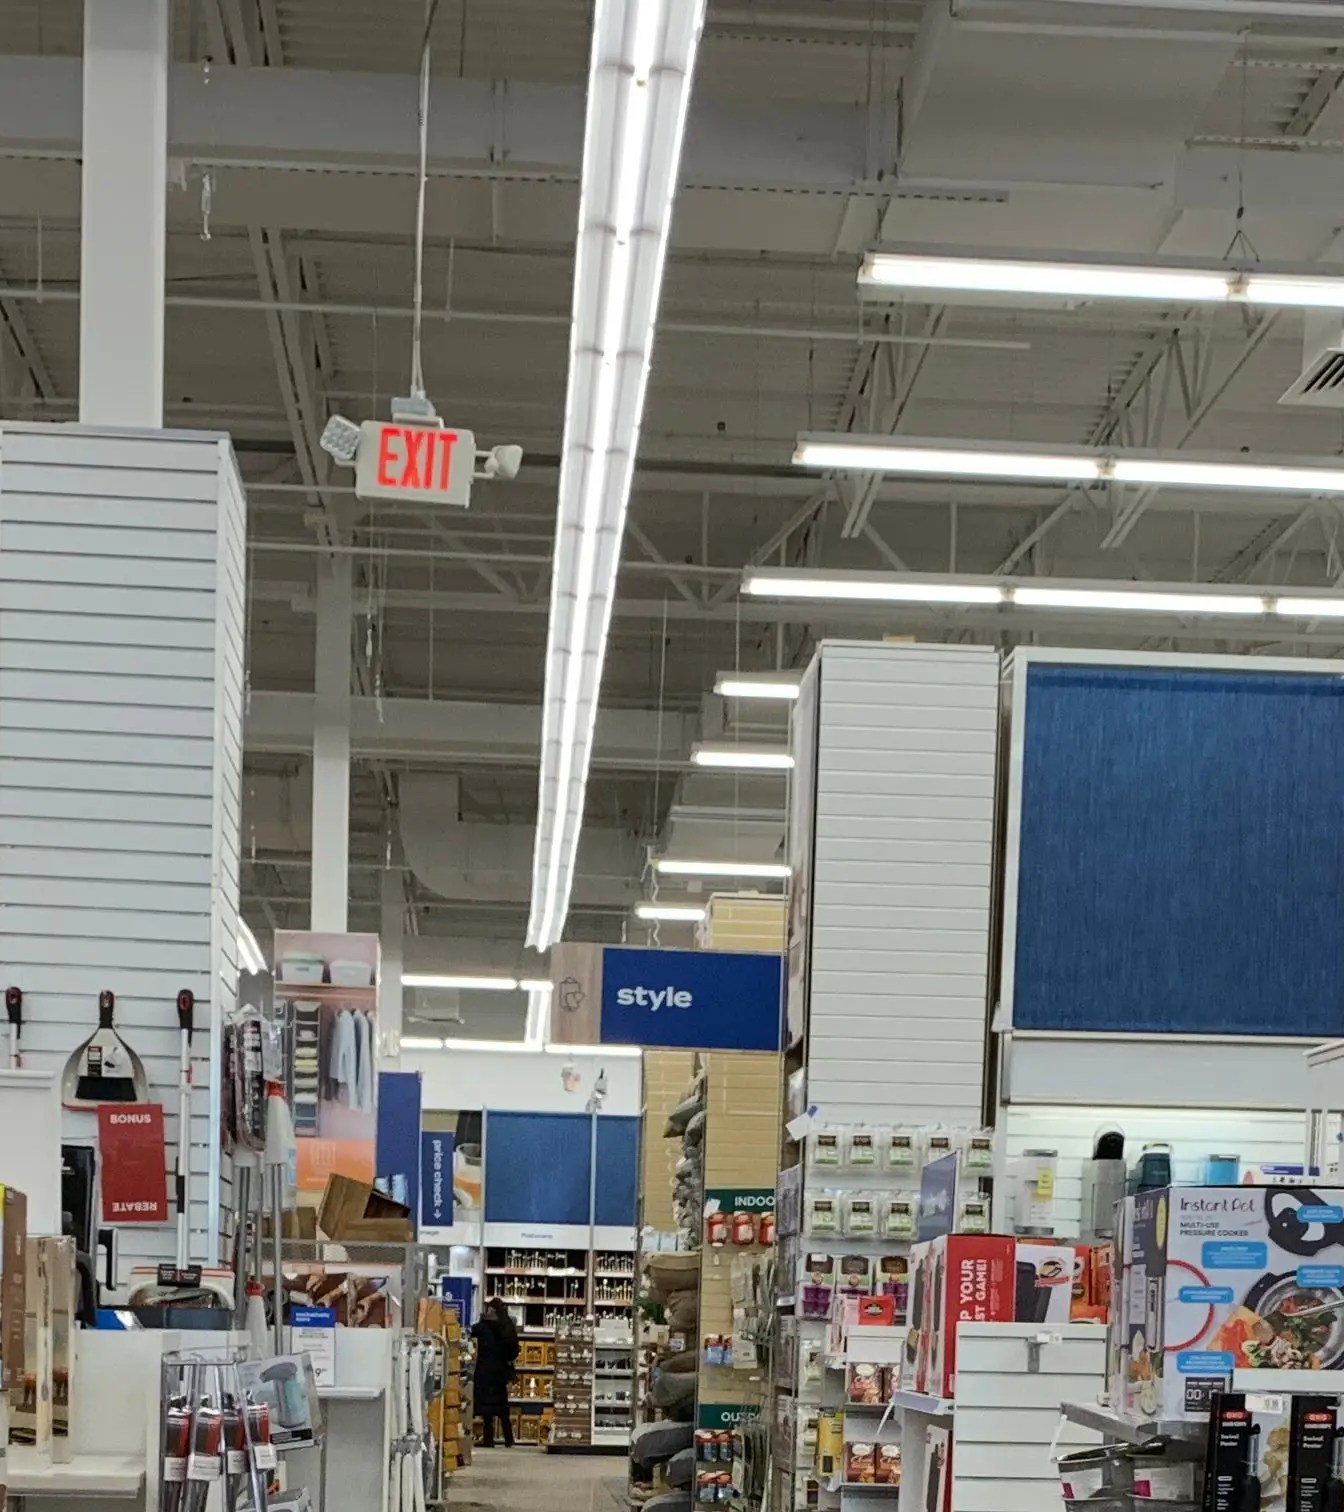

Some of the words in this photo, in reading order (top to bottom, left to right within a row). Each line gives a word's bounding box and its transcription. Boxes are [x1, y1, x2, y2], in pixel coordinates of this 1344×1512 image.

[376, 427, 458, 492] EXIT
[617, 986, 693, 1012] style
[110, 1114, 152, 1124] BONUS
[432, 1139, 444, 1170] price
[433, 1171, 444, 1207] check
[113, 1202, 157, 1212] REBATE
[1180, 1198, 1228, 1212] Instant
[1232, 1199, 1256, 1212] Pot
[960, 1259, 974, 1304] YOUR
[975, 1259, 987, 1301] GAME!
